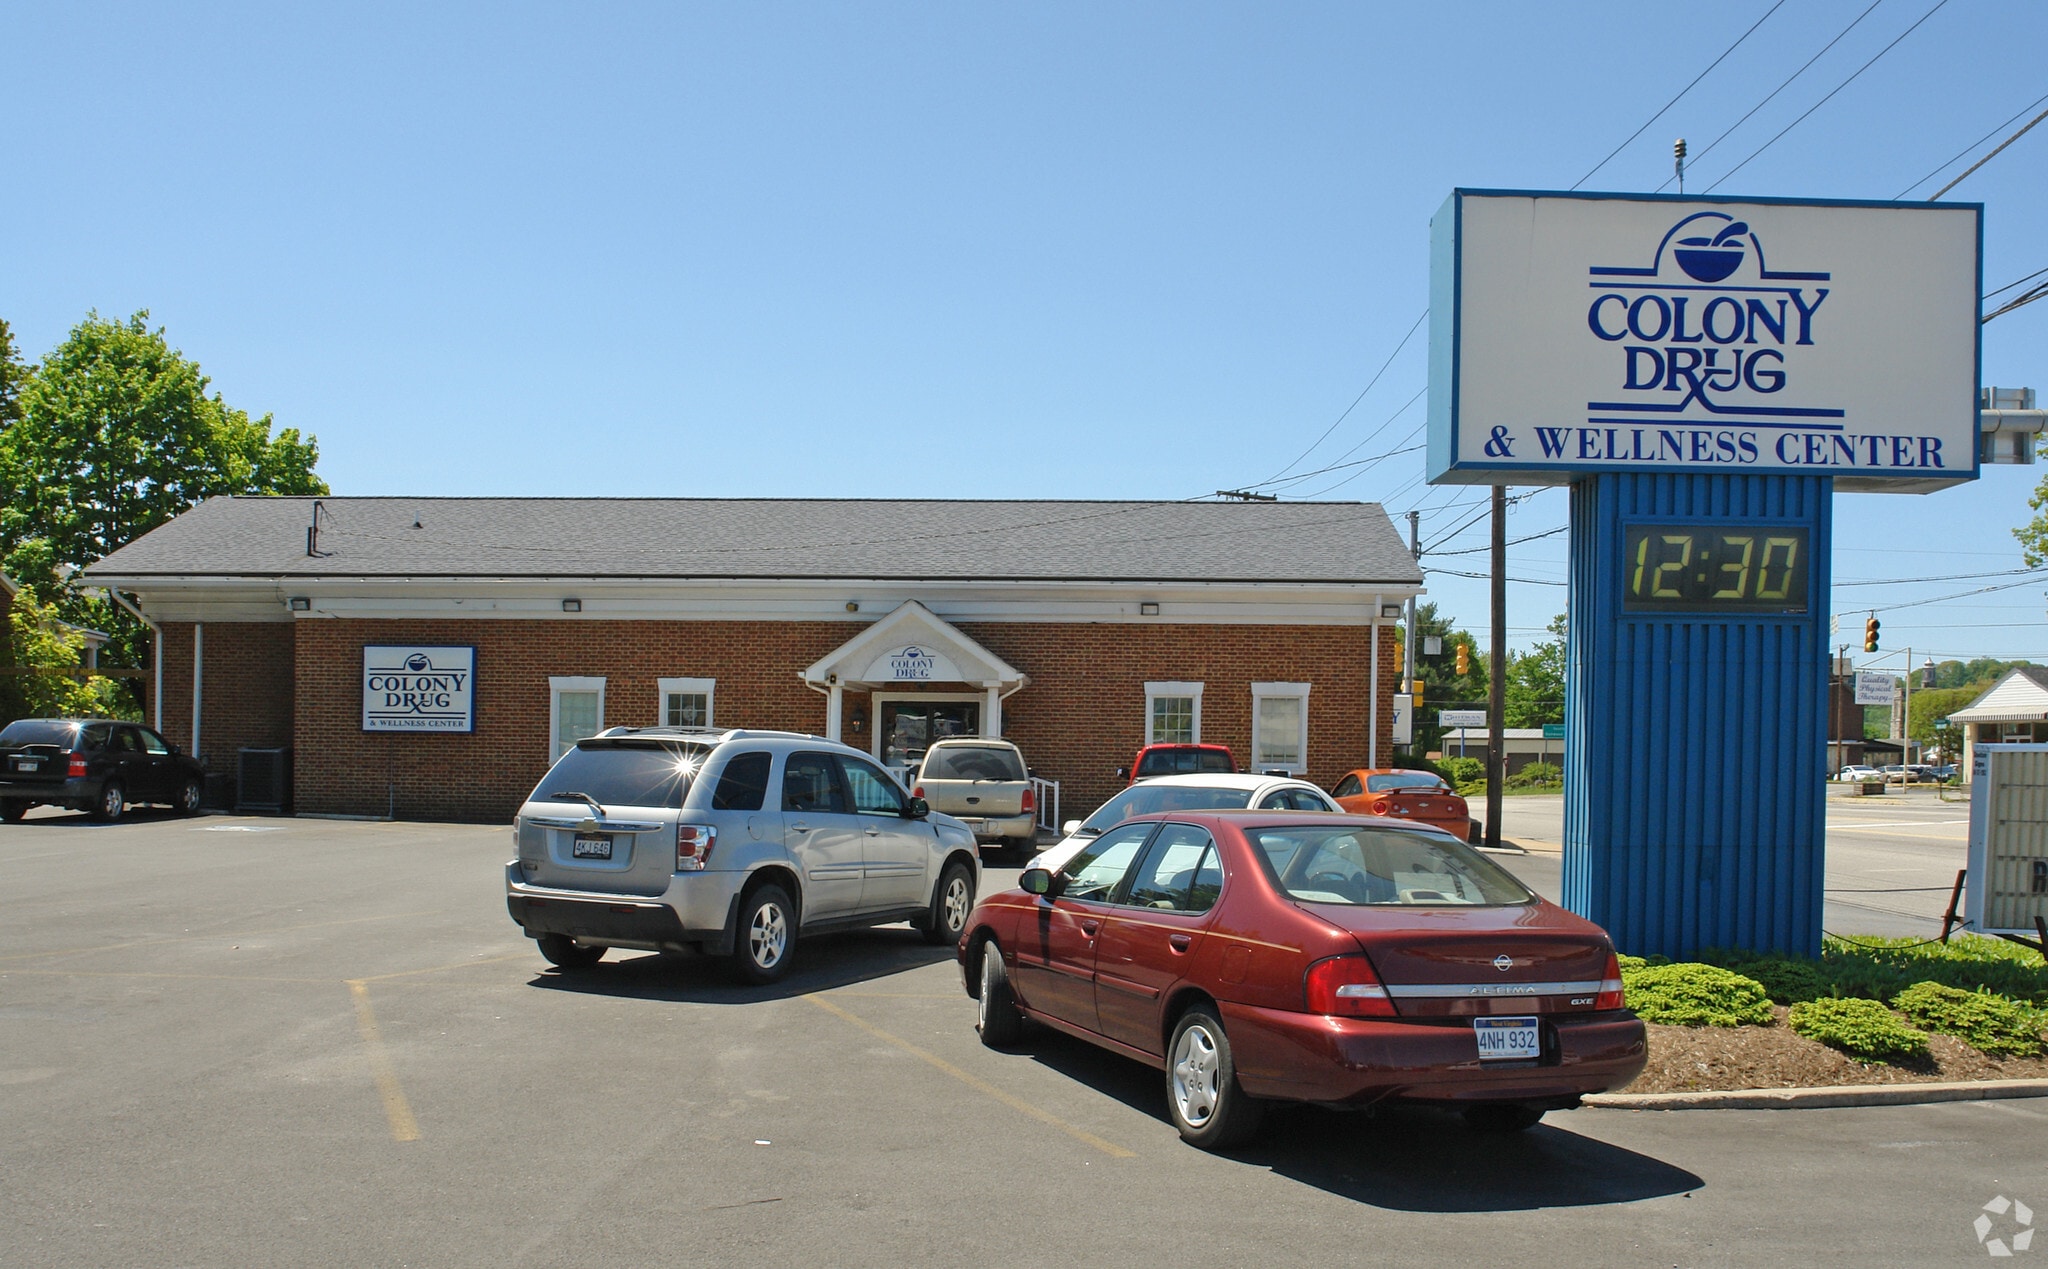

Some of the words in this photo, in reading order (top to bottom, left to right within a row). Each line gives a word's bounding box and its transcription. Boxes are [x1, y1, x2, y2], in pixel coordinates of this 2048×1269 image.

[1588, 288, 1829, 345] COLONY
[1623, 346, 1786, 394] DRUG
[1484, 425, 1516, 458] &
[1533, 427, 1759, 463] WELLNESS
[1775, 433, 1946, 468] CENTER
[1632, 535, 1798, 599] 12:30
[891, 658, 934, 668] COLONY
[896, 669, 929, 678] DRUG
[368, 674, 467, 691] COLONY
[1860, 685, 1892, 694] Physical
[385, 693, 450, 707] DRUG
[1859, 693, 1888, 702] Therapy
[1469, 985, 1535, 994] ALTIMA
[1570, 997, 1594, 1005] GXE
[1479, 1031, 1505, 1049] 4NH
[1509, 1030, 1535, 1048] 932
